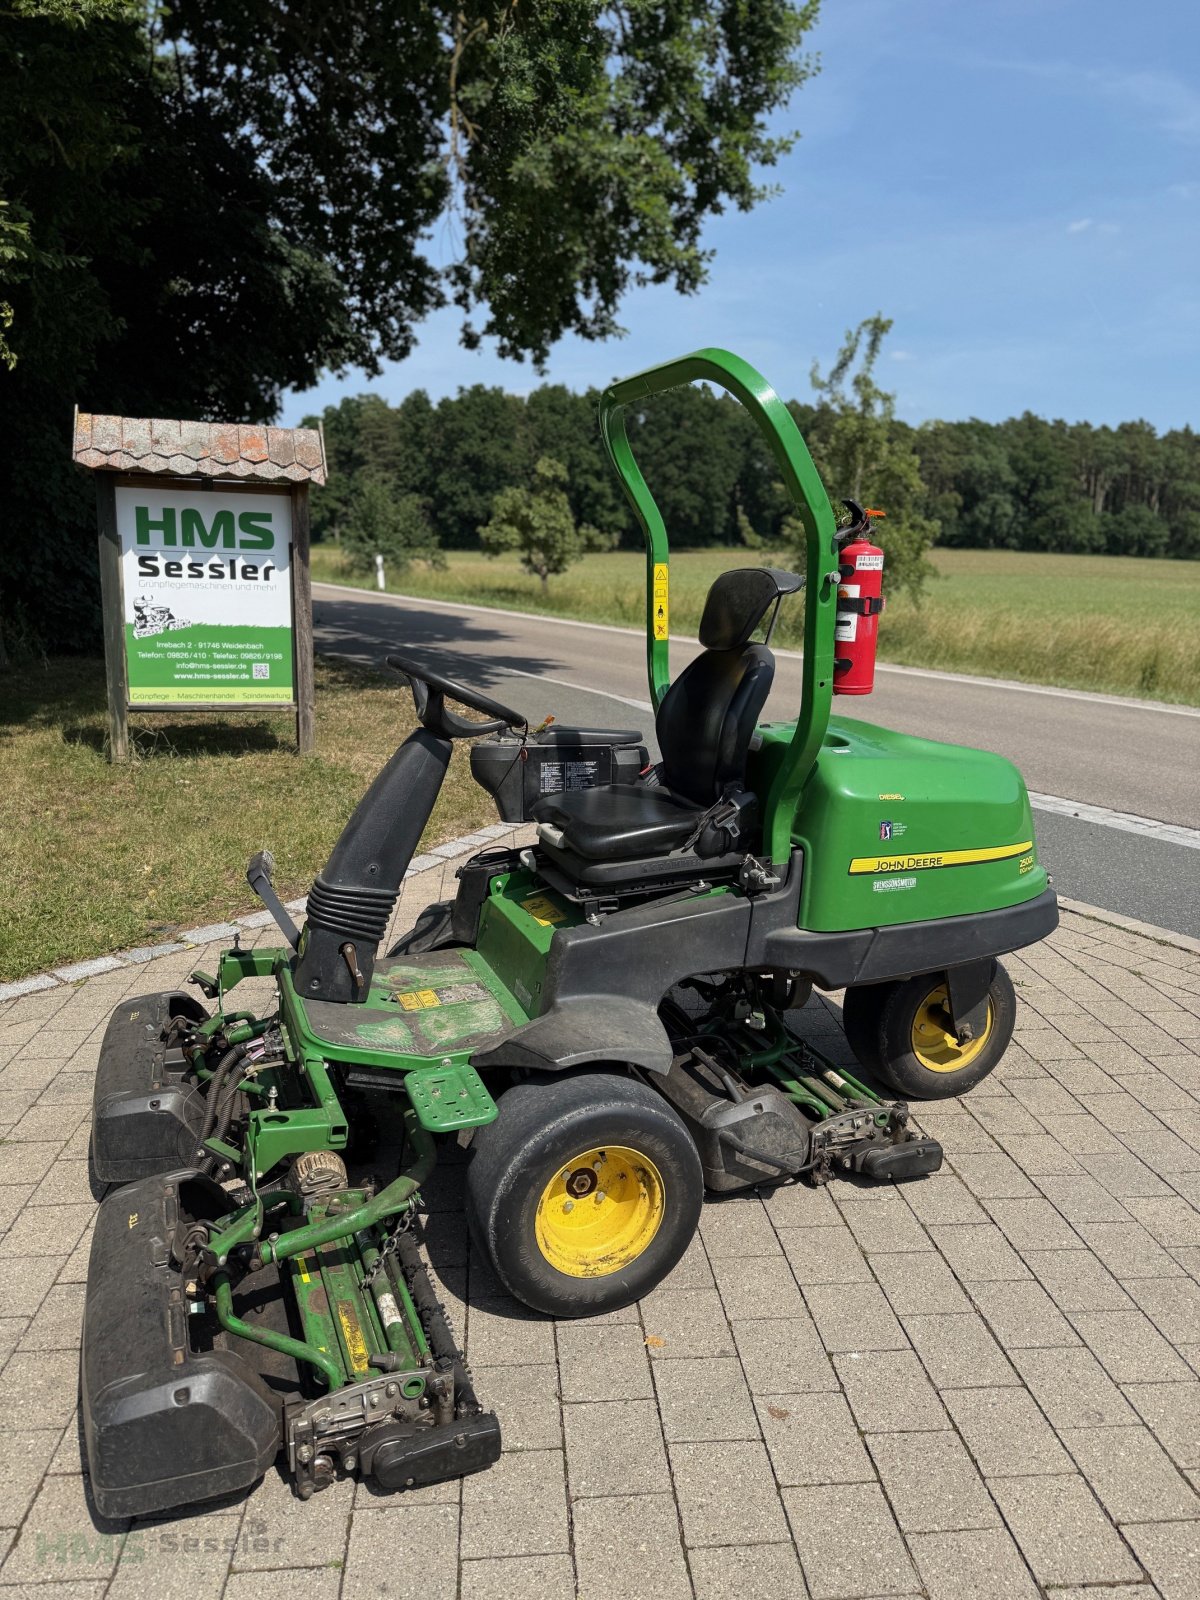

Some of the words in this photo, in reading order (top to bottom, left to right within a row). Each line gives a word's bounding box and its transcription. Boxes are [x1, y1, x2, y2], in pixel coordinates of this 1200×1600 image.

[135, 506, 275, 550] HMS
[138, 556, 276, 581] Sessler
[138, 580, 233, 591] Grünpflegemaschinen
[235, 583, 251, 591] und
[253, 583, 277, 592] mehr!
[156, 641, 186, 649] Irrebach
[222, 642, 264, 650] Weidenbach
[176, 662, 247, 670] info@hms-sessler.de
[132, 693, 170, 701] Grünpflege
[177, 692, 236, 700] Maschinenhandel
[242, 692, 291, 701] Spindelwartung
[874, 860, 905, 872] JOHN
[907, 857, 943, 869] DEERE
